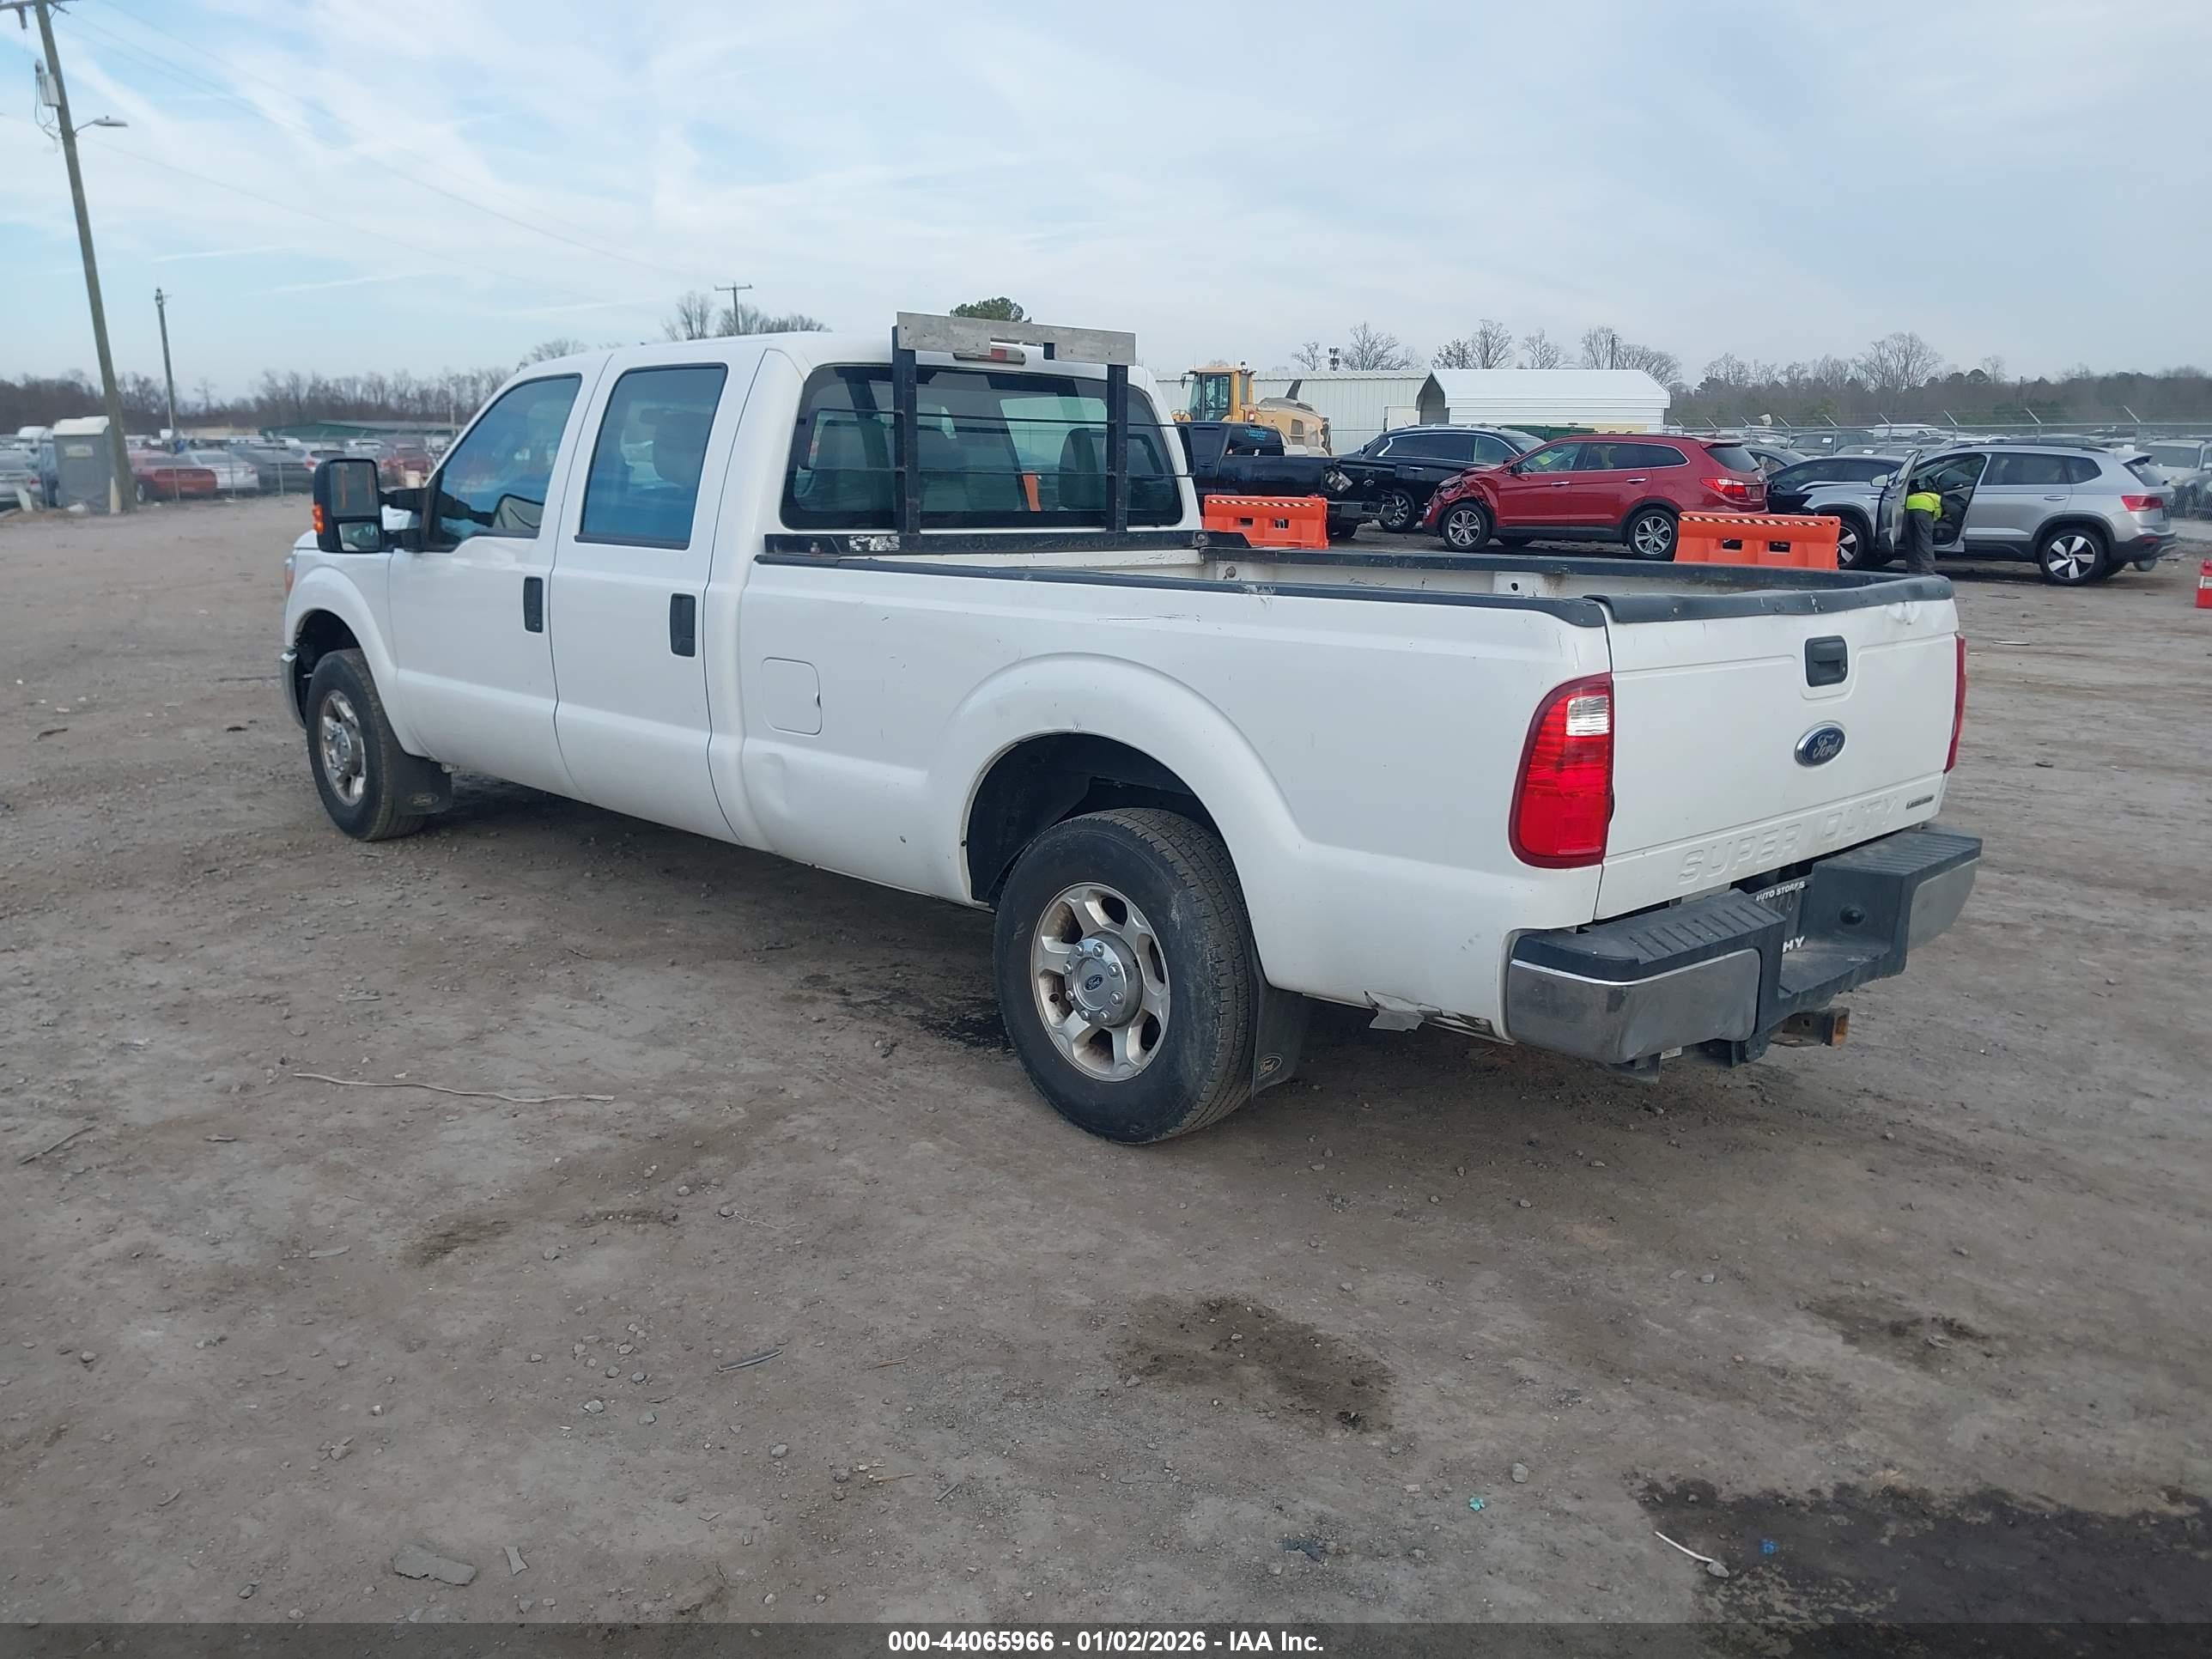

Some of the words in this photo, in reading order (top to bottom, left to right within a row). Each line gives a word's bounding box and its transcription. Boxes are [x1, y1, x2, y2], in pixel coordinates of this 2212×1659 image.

[1812, 733, 1840, 759] Ford
[1677, 823, 1802, 885] SUPER
[1820, 795, 1898, 845] DUTY
